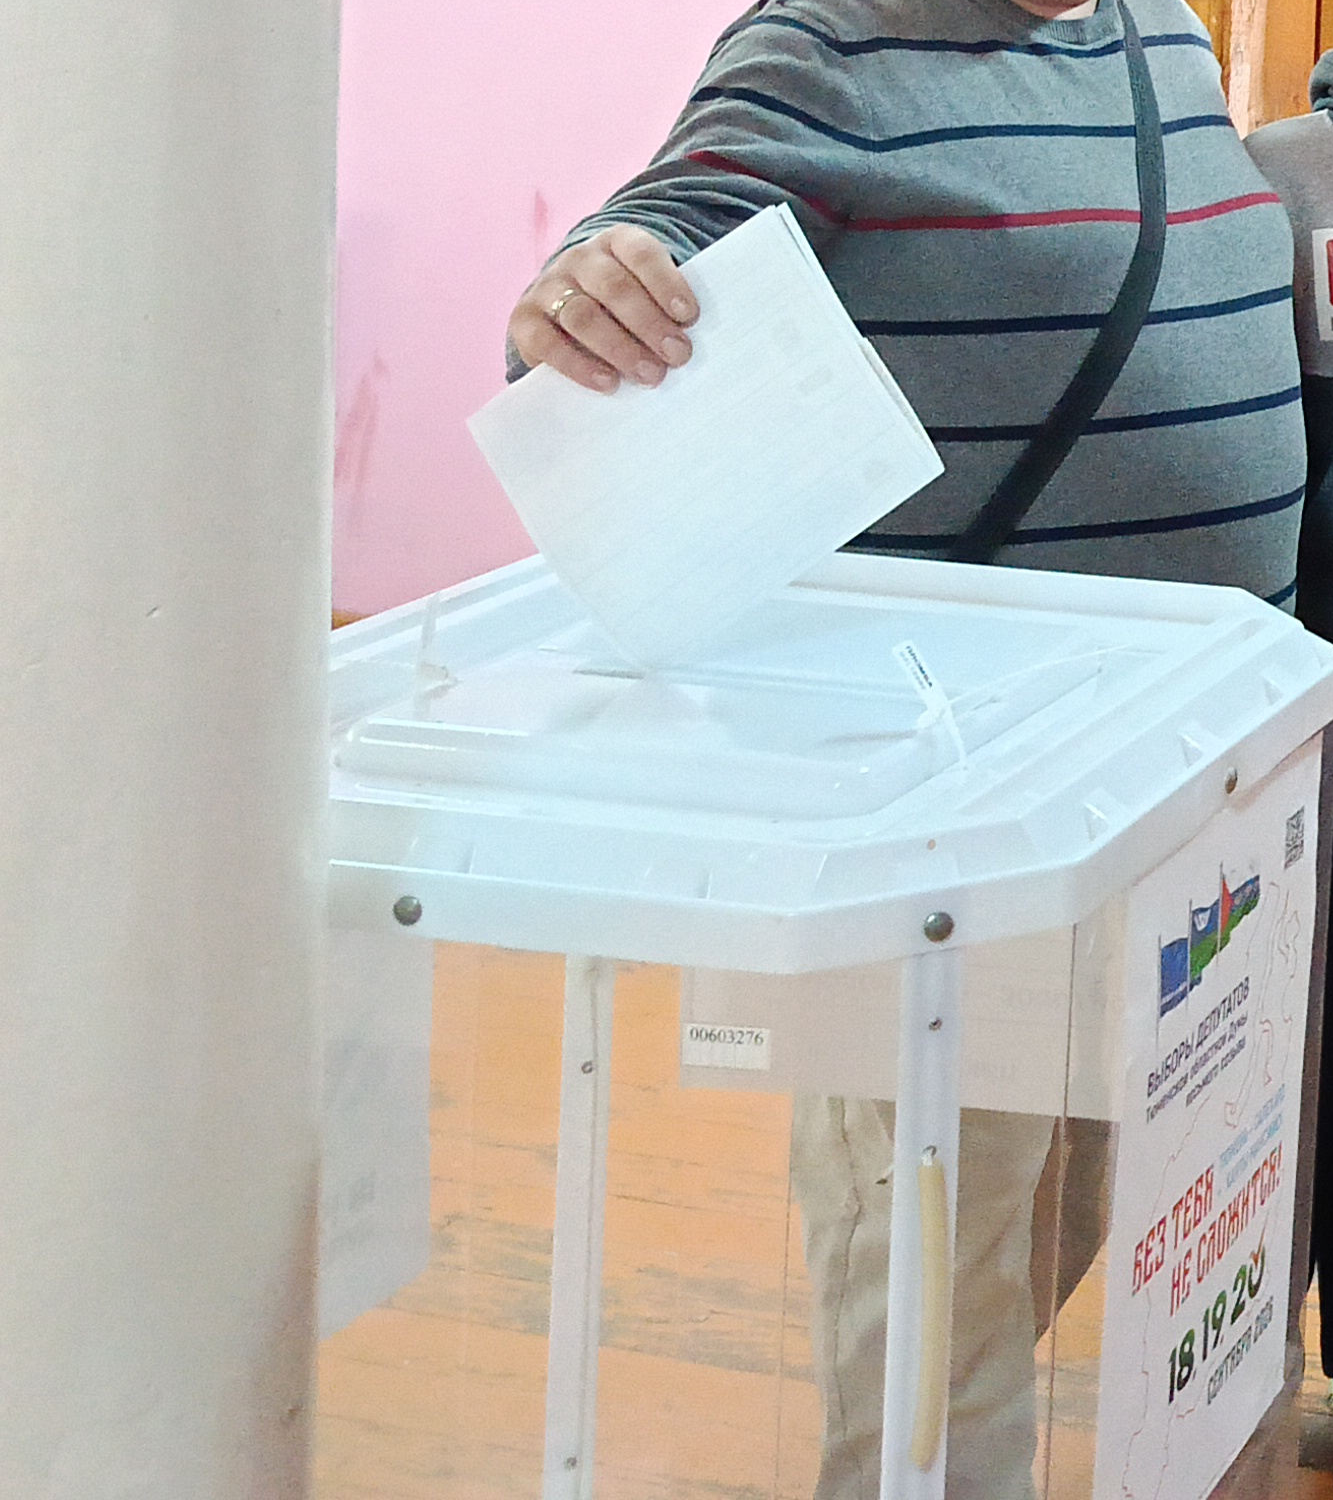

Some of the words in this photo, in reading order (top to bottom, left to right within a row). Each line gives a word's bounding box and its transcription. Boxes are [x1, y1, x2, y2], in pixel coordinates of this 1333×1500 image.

[690, 1027, 764, 1045] 00603276
[1147, 1031, 1195, 1098] ВЫБОРЫ
[1195, 976, 1250, 1053] ДЕПУТАТОВ
[1132, 1214, 1167, 1297] БЕЗ
[1172, 1164, 1214, 1250] ТЕБЯ
[1170, 1248, 1192, 1317] НЕ
[1197, 1140, 1283, 1284] СЛОЖИТСЯ!
[1230, 1244, 1265, 1326] 20
[1207, 1324, 1252, 1406] СЕНТЯБРЯ
